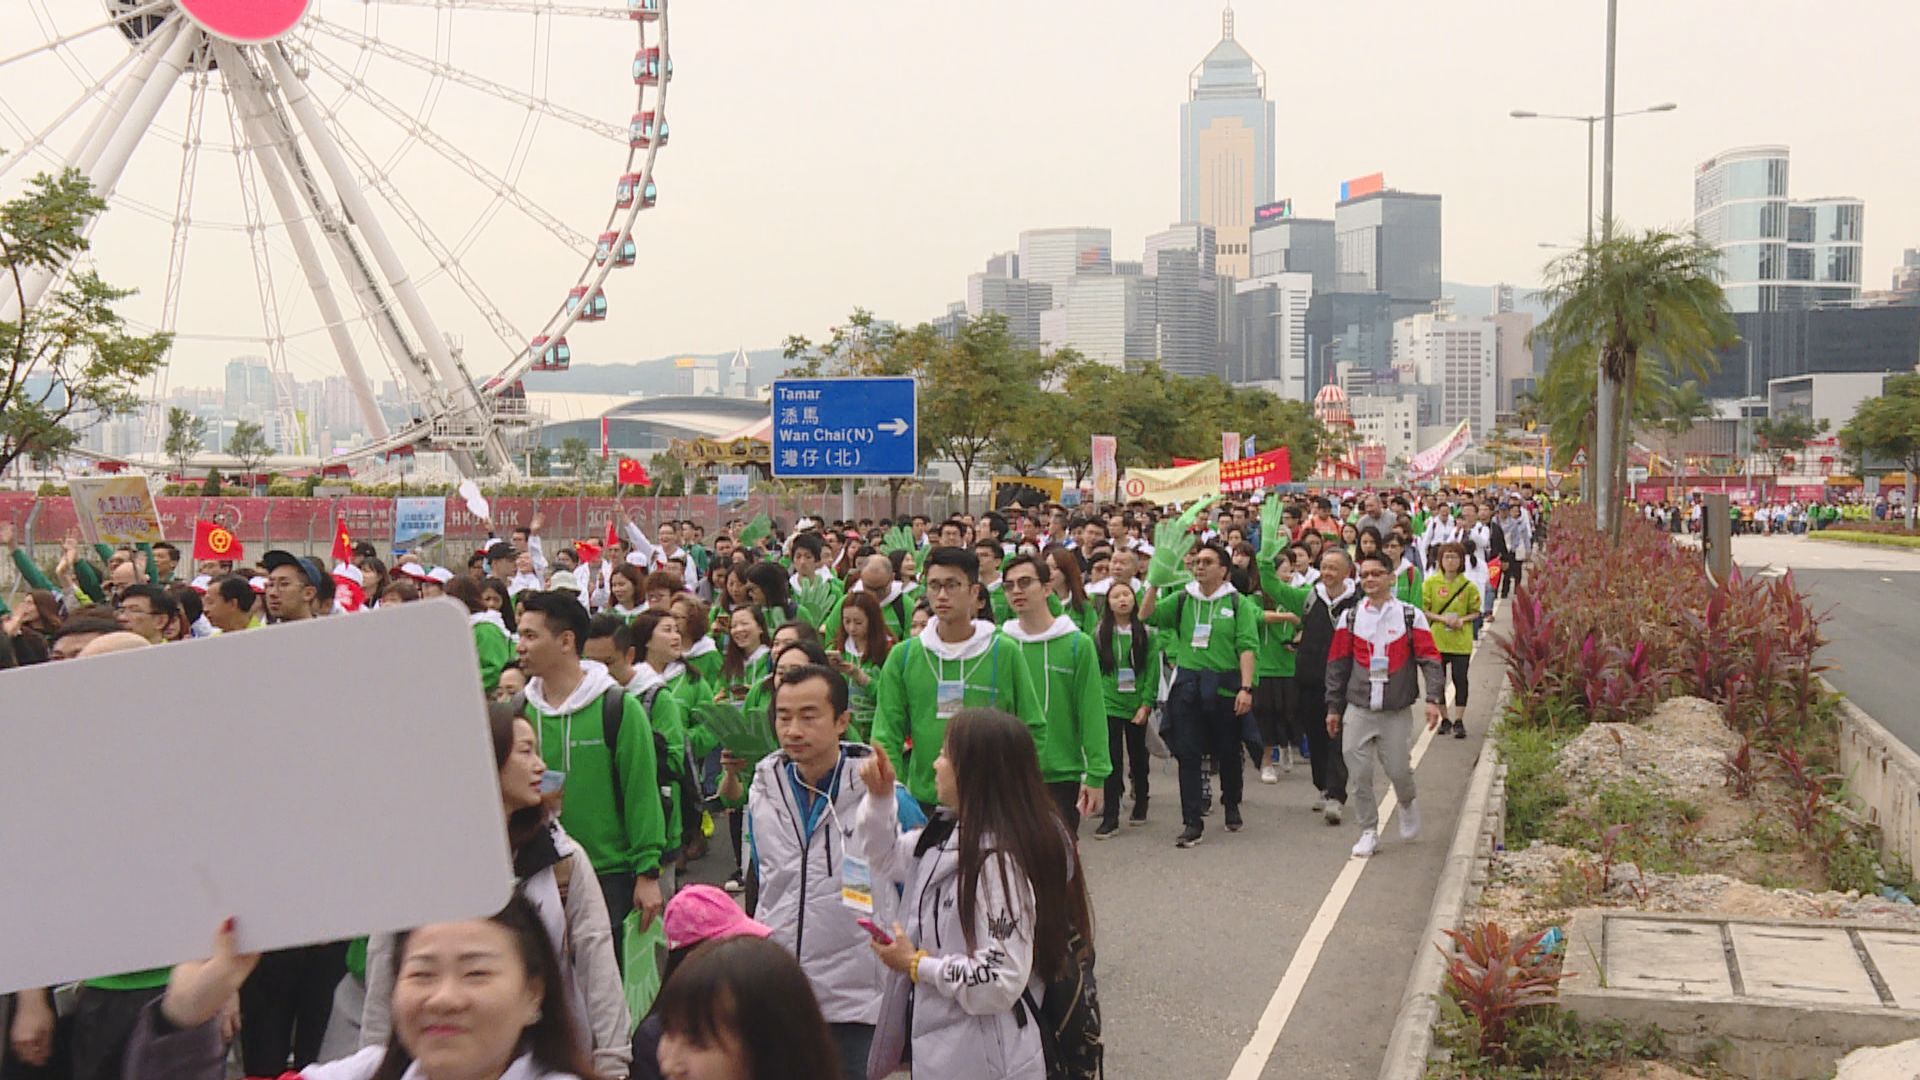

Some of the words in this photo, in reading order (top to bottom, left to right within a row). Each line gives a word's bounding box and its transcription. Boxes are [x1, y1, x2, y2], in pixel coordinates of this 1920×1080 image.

[778, 388, 821, 400] Tamar
[781, 406, 820, 425] 添馬
[779, 428, 810, 442] Wan
[813, 428, 874, 443] Chai(N)
